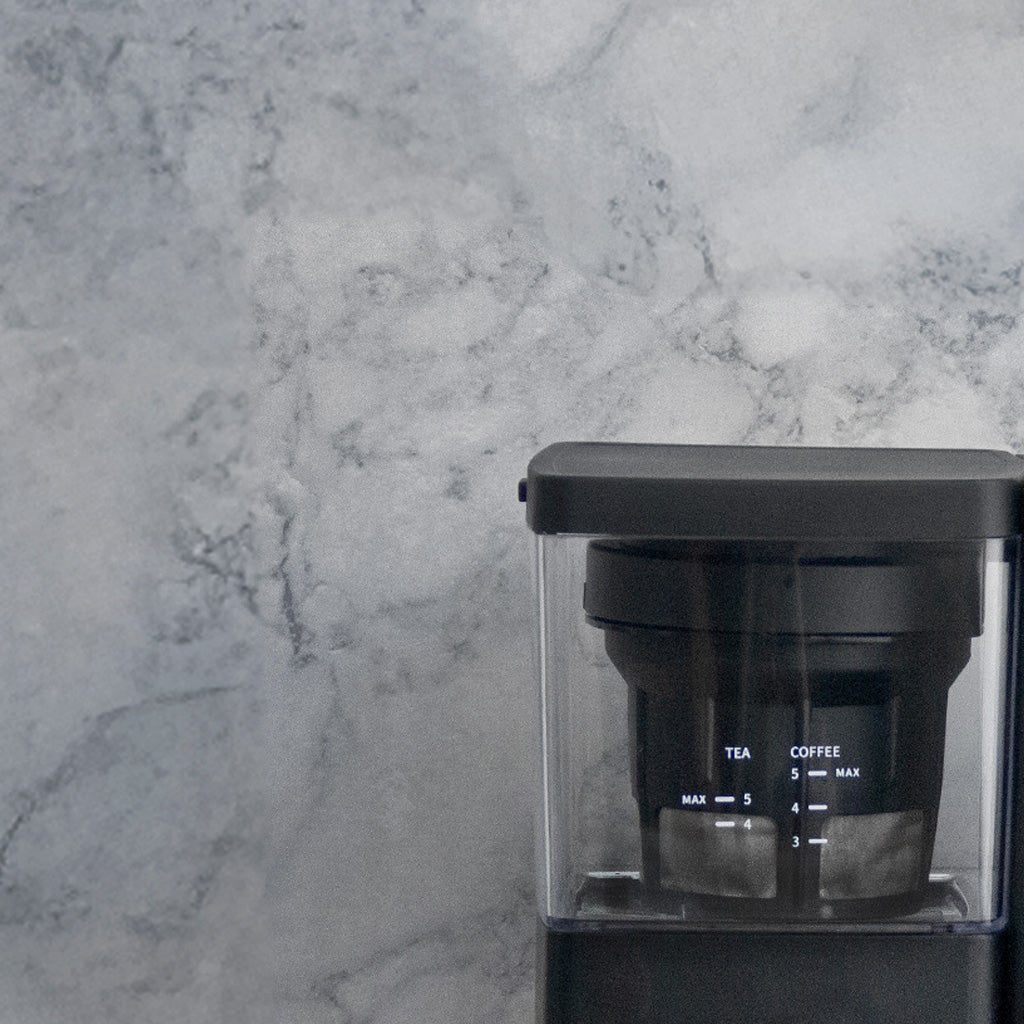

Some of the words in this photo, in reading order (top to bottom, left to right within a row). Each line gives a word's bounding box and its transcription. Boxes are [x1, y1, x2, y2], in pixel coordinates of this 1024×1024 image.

[725, 746, 751, 759] TEA
[790, 745, 841, 758] COFFEE
[791, 767, 799, 780] 5
[836, 767, 860, 778] MAX
[682, 794, 706, 805] MAX
[743, 793, 752, 805] 5
[791, 802, 800, 814] 4
[743, 819, 752, 830] 4
[791, 835, 800, 848] 3
